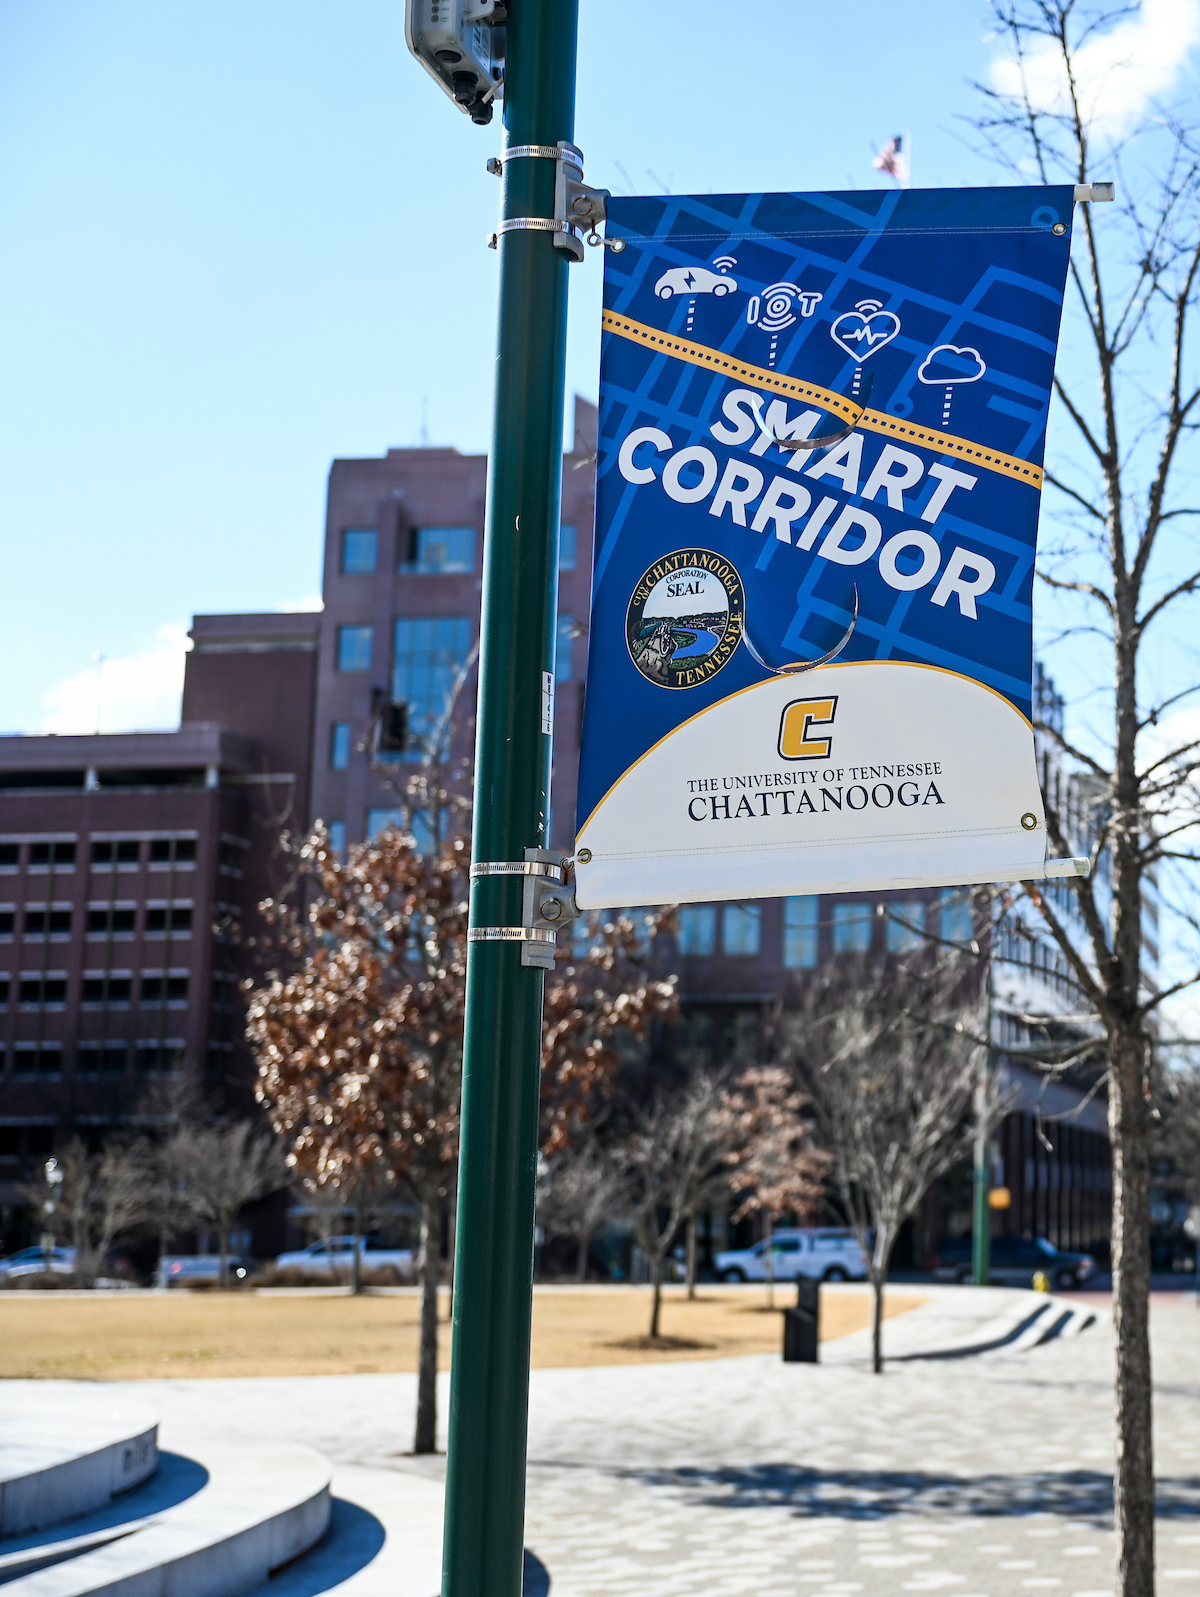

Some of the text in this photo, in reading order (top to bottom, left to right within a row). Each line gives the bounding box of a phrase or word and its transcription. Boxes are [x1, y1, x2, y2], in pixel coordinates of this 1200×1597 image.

[709, 388, 979, 524] SMART
[617, 426, 996, 620] CORRIDOR
[633, 584, 647, 606] CITY
[645, 553, 740, 595] CHATTANOOGA
[665, 569, 708, 584] CORPORATION
[666, 581, 705, 598] SEAL
[676, 611, 742, 686] TENNESSEE
[777, 695, 839, 761] C
[687, 761, 943, 792] THE UNIVERSITY OF TENNESSEE
[688, 780, 945, 822] CHATTANOOGA
